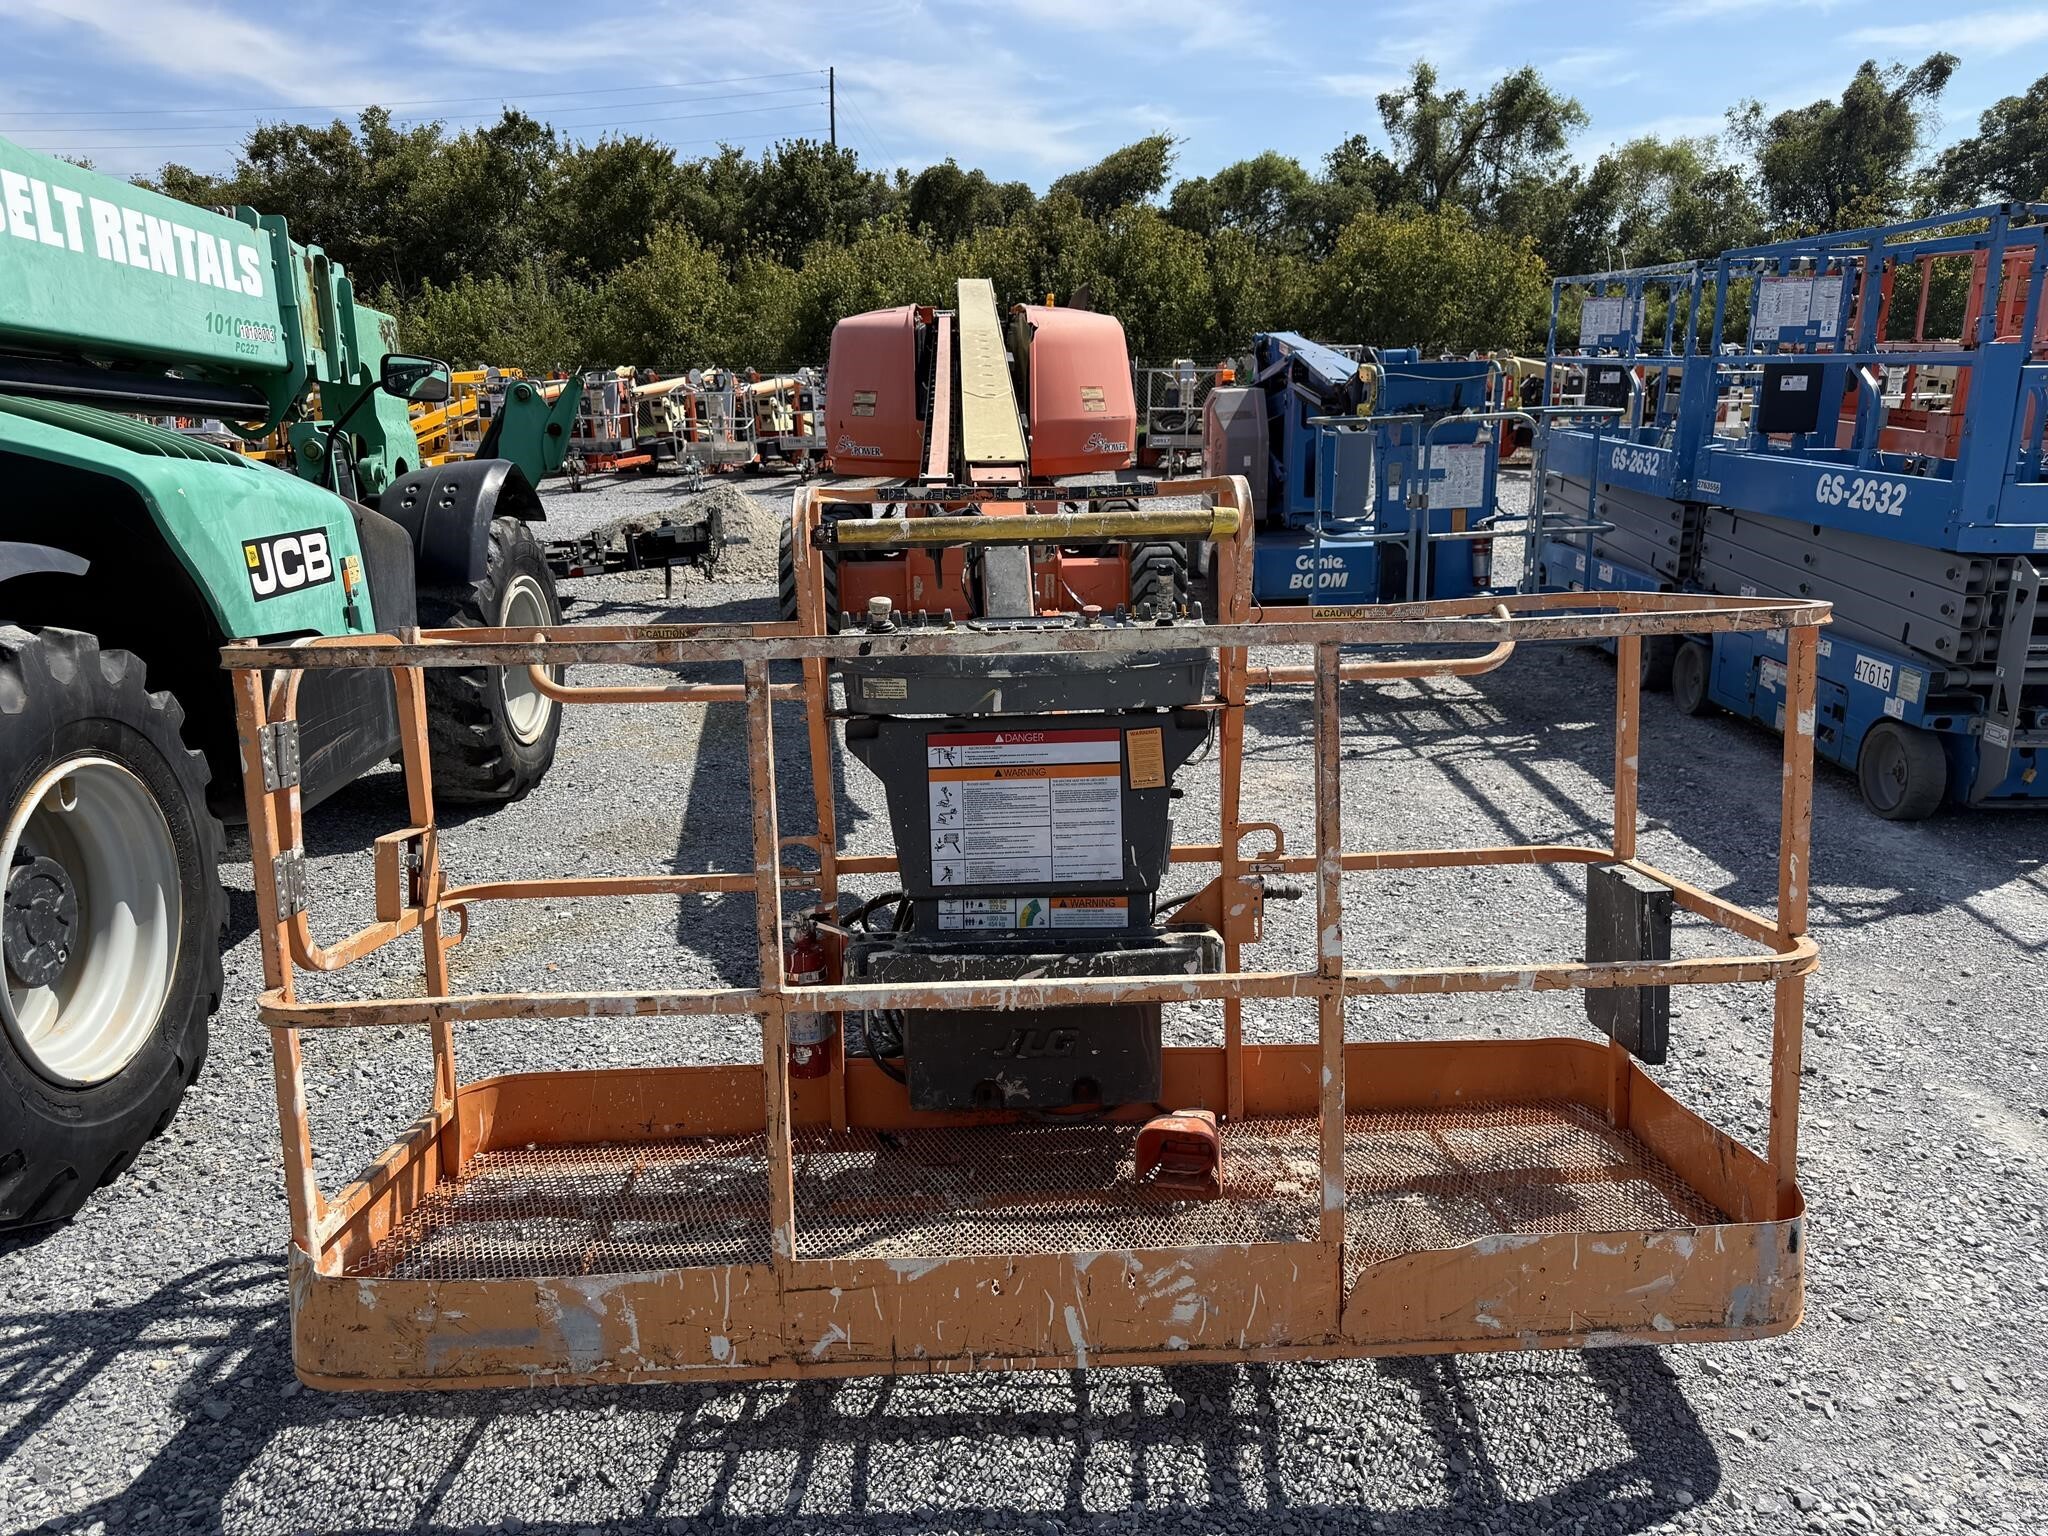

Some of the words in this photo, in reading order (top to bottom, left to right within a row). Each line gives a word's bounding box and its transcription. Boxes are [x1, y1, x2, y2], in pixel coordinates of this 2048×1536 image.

[0, 169, 84, 253] ELT
[89, 196, 264, 298] RENTALS
[235, 341, 259, 355] PC227
[1611, 446, 1660, 476] GS-2632
[1816, 473, 1907, 517] GS-2632
[251, 532, 332, 595] JCB
[1289, 572, 1349, 589] BOOM
[1855, 659, 1891, 690] 47615
[1005, 733, 1045, 743] DANGER
[1003, 768, 1047, 777] WARNING
[1070, 901, 1116, 909] WARNING
